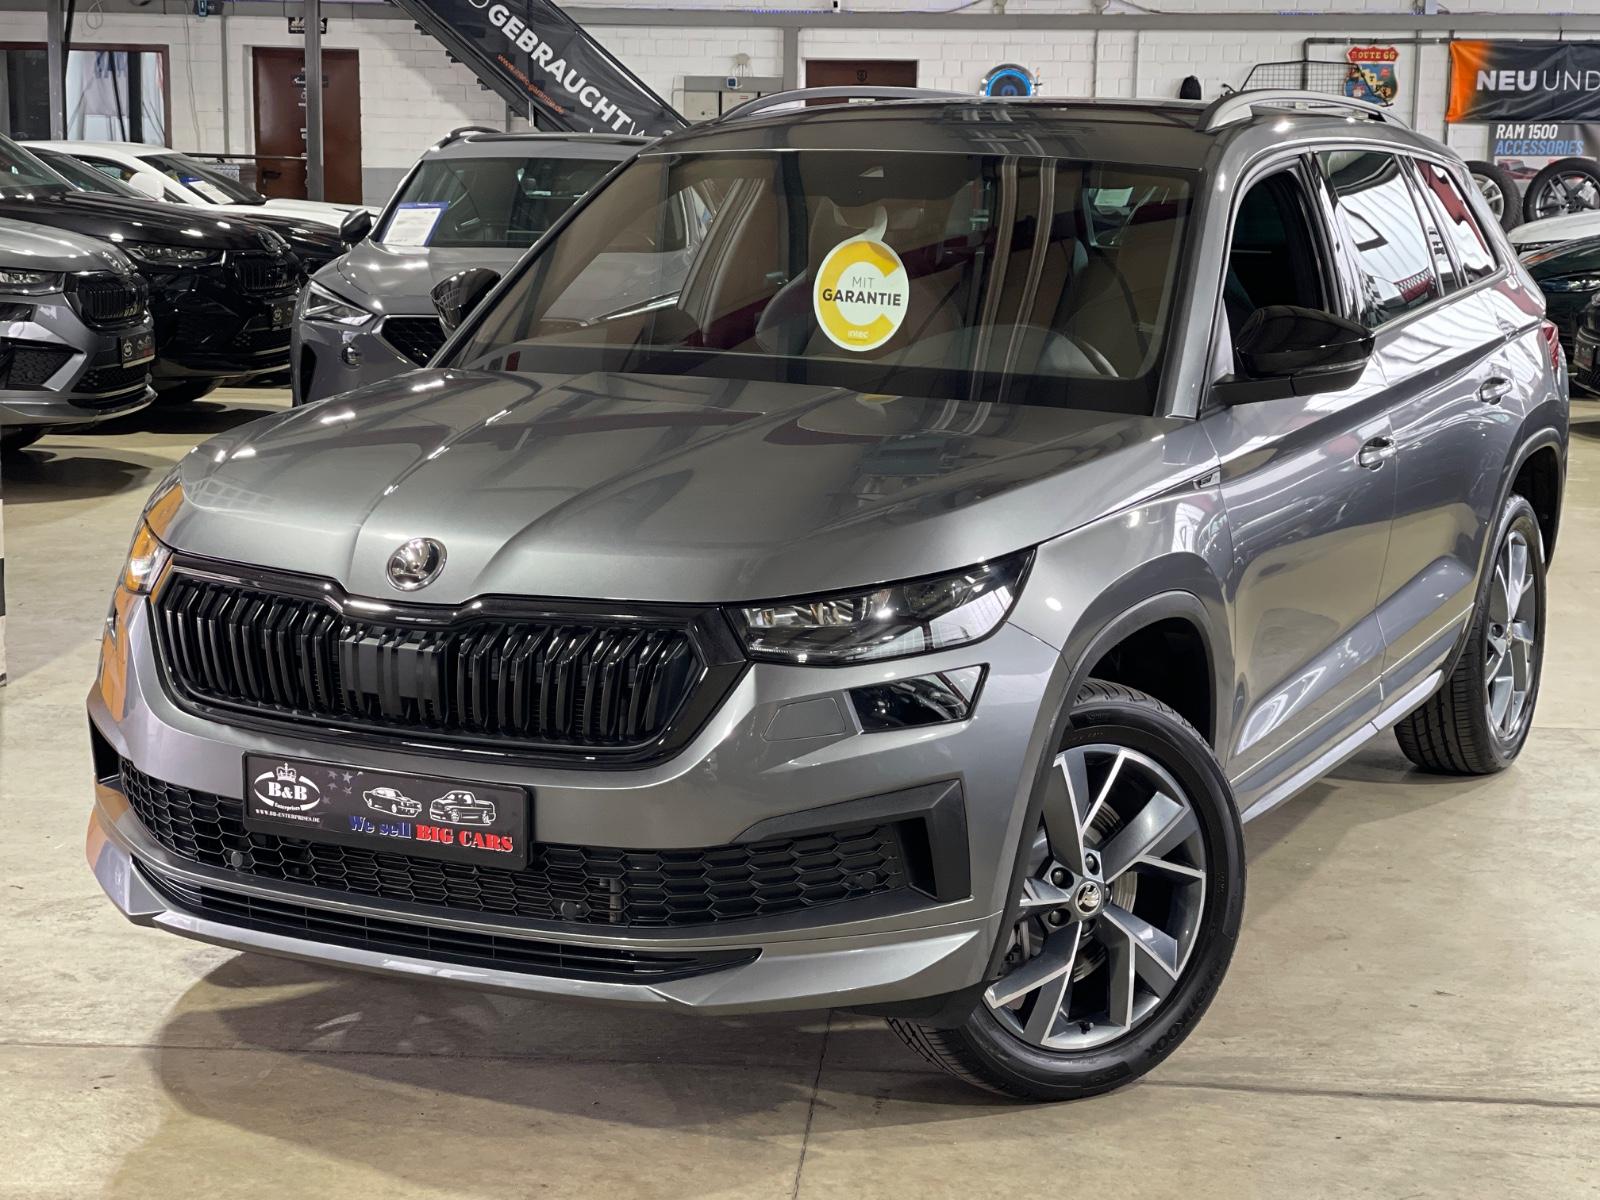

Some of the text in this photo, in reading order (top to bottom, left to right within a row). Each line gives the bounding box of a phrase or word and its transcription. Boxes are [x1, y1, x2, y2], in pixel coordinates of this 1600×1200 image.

[1383, 51, 1396, 60] 66
[1476, 70, 1600, 91] NEU UND
[1496, 124, 1558, 140] RAM 1500
[1495, 140, 1584, 156] ACCESSORIES
[851, 276, 877, 288] MIT
[822, 288, 902, 306] GARANTIE
[268, 781, 308, 801] B&B
[349, 815, 514, 853] We sell BIG CARS
